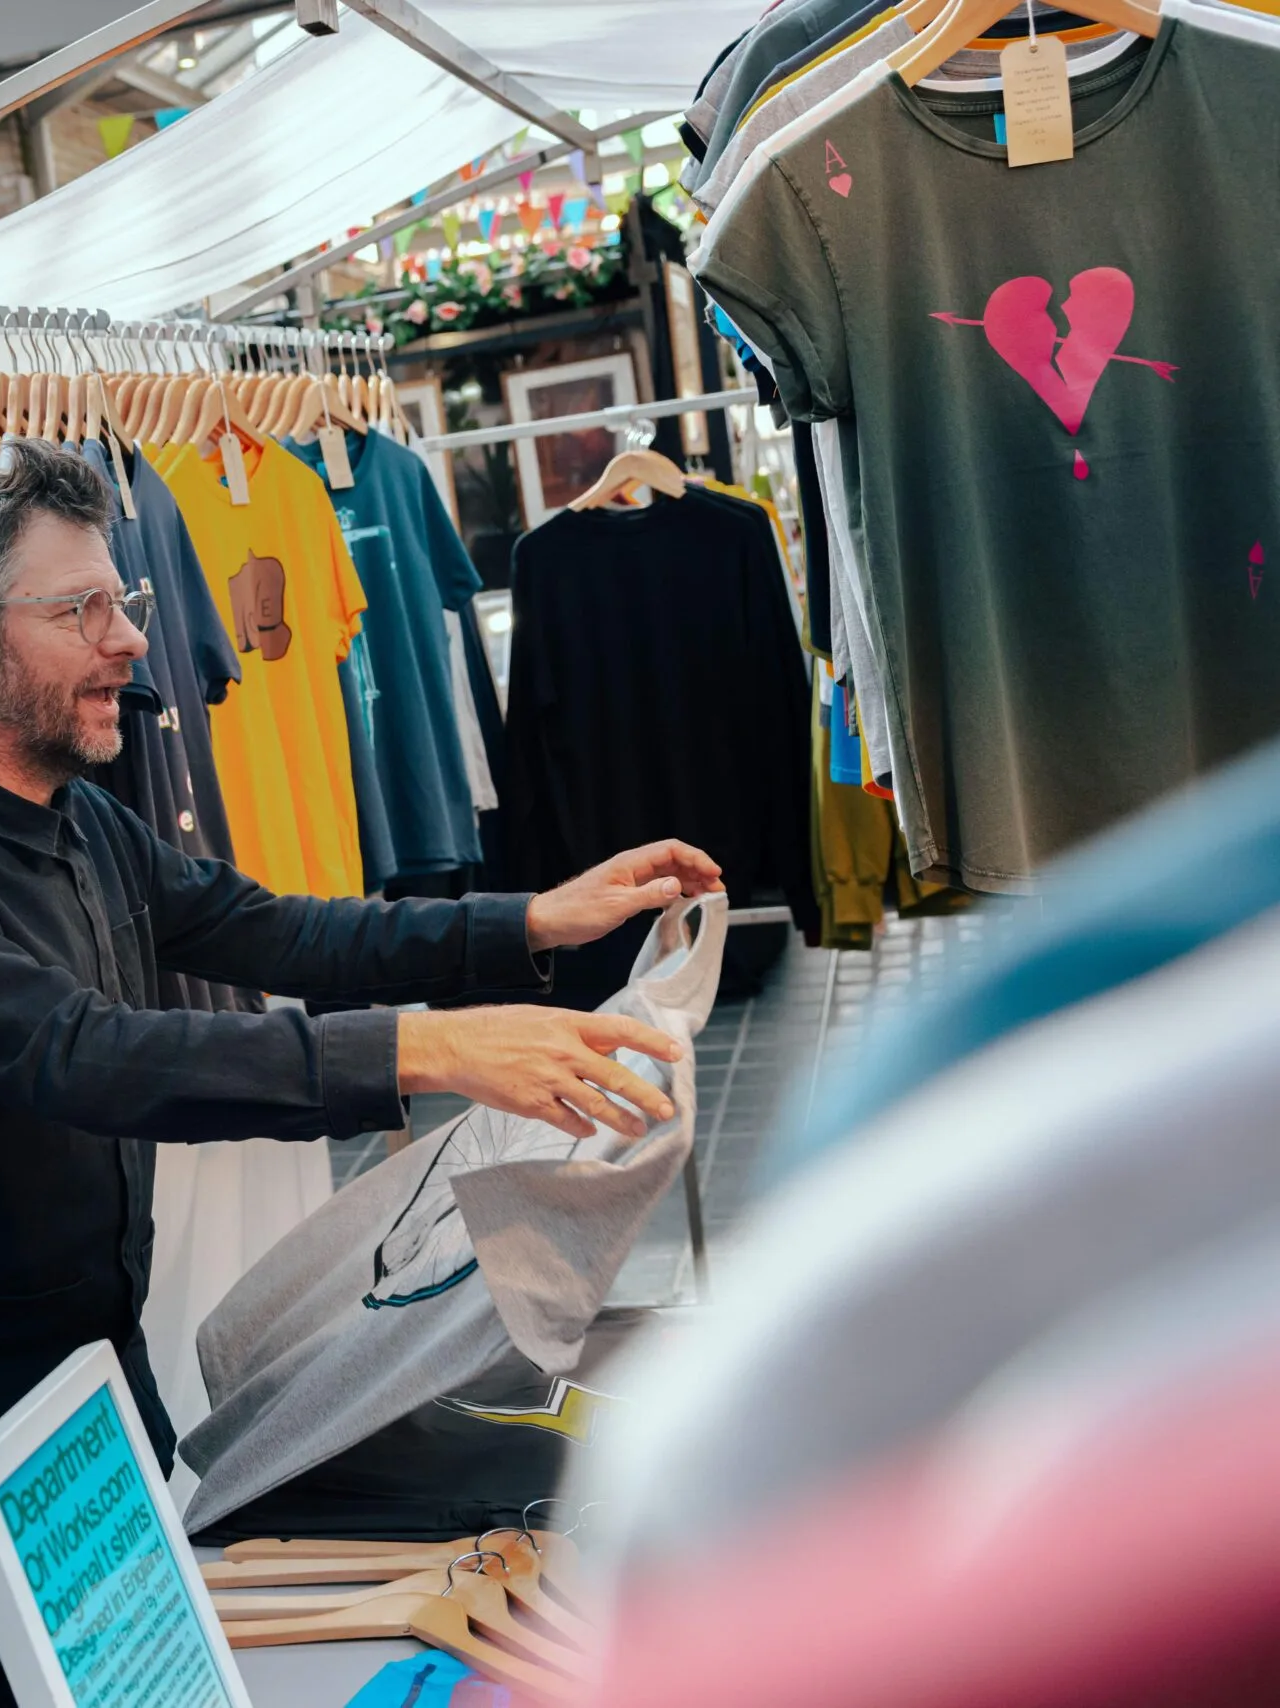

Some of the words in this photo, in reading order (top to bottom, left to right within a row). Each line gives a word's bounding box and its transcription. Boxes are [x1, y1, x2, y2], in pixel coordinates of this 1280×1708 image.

[824, 138, 848, 174] A
[261, 599, 273, 617] E
[0, 1401, 118, 1541] Department
[22, 1543, 51, 1594] Of
[48, 1460, 136, 1567] Works.com
[41, 1549, 105, 1638] Original
[99, 1545, 114, 1574] t
[110, 1502, 151, 1561] shirts
[57, 1601, 115, 1675] Designed
[110, 1590, 125, 1614] in
[121, 1535, 163, 1597] England
